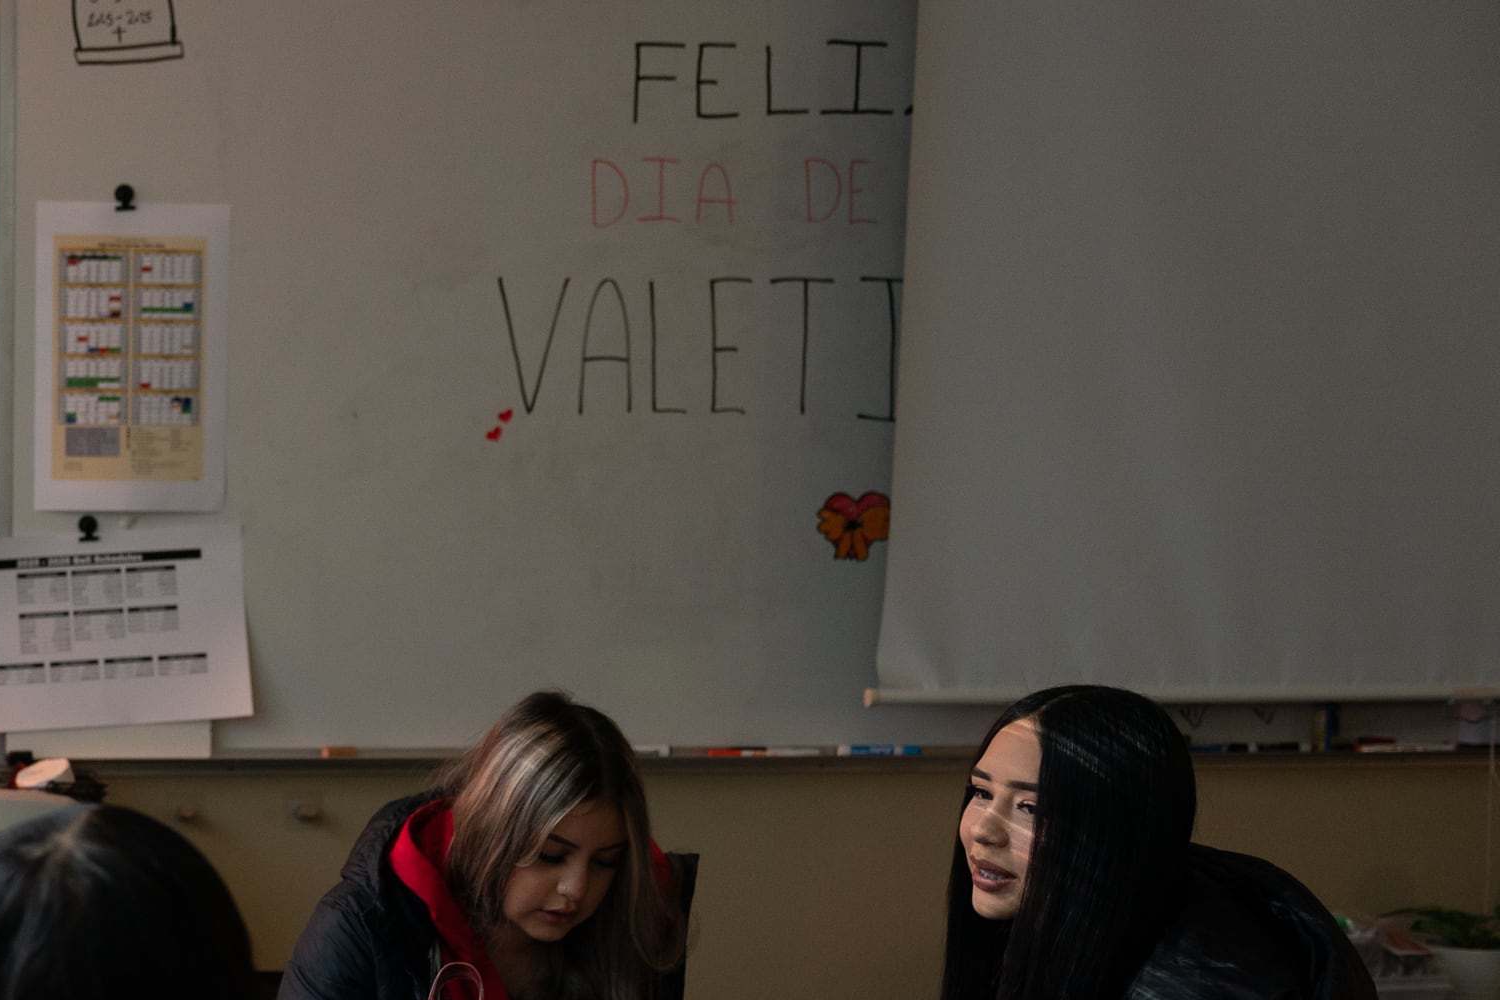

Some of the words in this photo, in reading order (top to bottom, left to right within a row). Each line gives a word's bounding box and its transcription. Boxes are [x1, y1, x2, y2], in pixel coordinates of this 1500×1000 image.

[633, 40, 914, 124] FELI
[591, 156, 736, 228] DIA
[804, 157, 878, 225] DE
